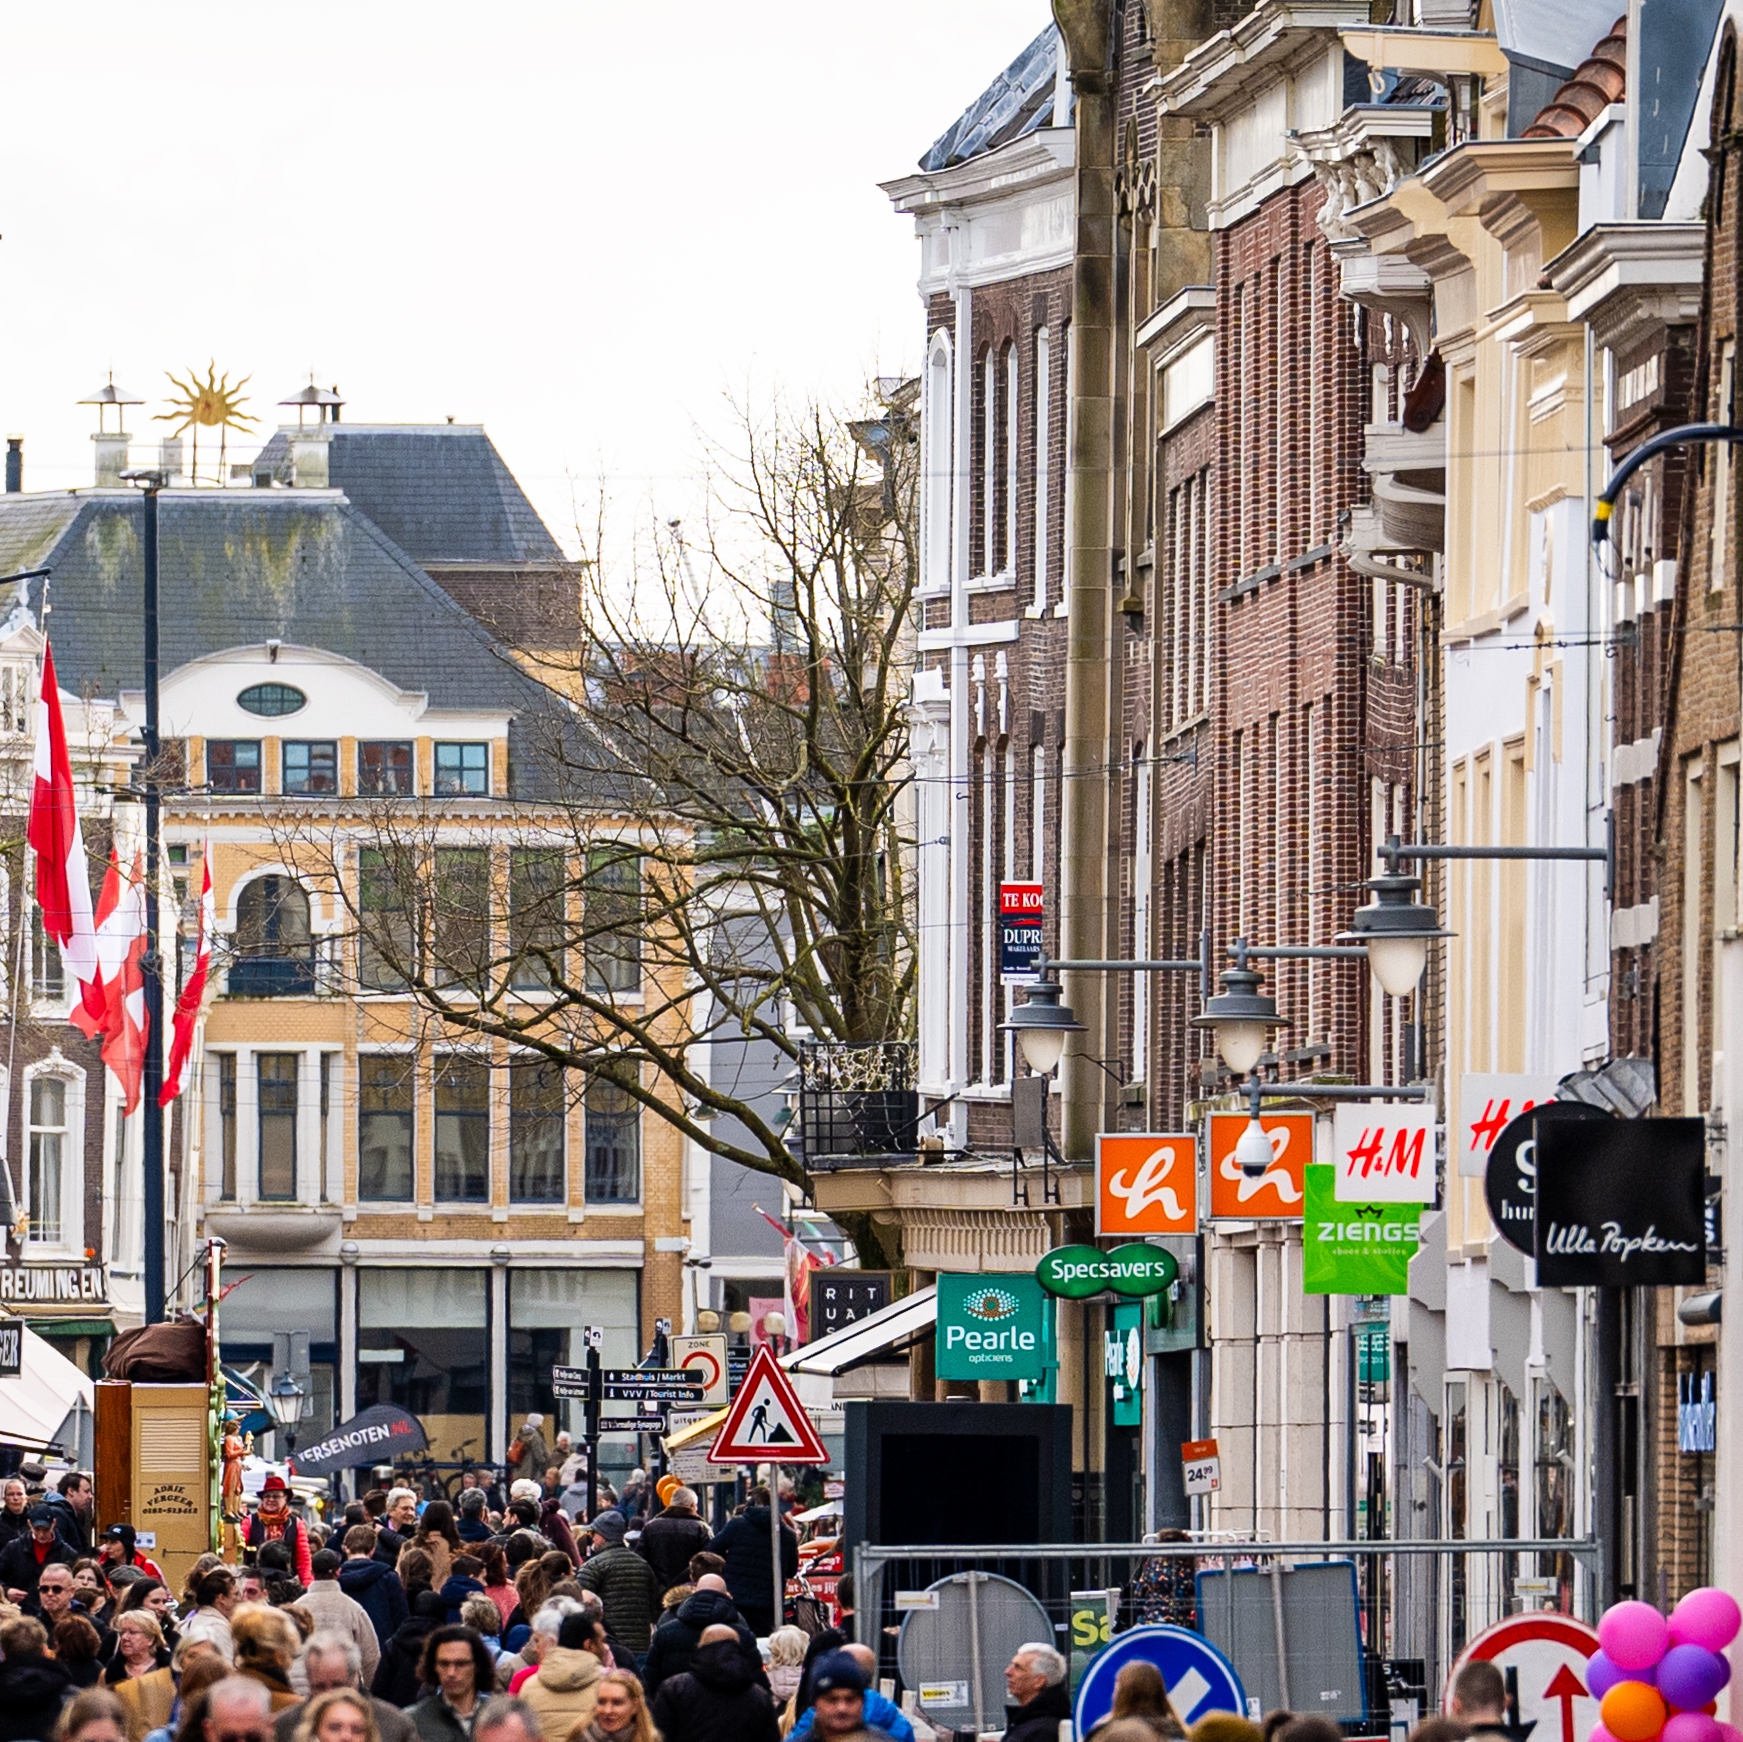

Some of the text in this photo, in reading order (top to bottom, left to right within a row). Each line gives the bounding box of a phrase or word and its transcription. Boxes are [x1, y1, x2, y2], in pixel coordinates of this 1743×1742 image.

[1003, 893, 1019, 907] TE
[1004, 929, 1043, 943] DUPR
[1346, 1127, 1426, 1180] H&M
[1317, 1222, 1420, 1242] ZIENGS
[1547, 1221, 1597, 1255] Ulla
[1599, 1221, 1699, 1263] Popken
[1051, 1258, 1165, 1283] Specsavers
[687, 1341, 711, 1349] ZONE
[946, 1326, 1035, 1350] Pearle
[968, 1353, 1013, 1364] opticiens
[621, 1372, 656, 1381] Stadhuis
[662, 1372, 686, 1381] Markt
[622, 1389, 642, 1397] VVV
[650, 1389, 676, 1398] Tourist
[678, 1389, 695, 1399] Info
[154, 1485, 185, 1495] ADRIE
